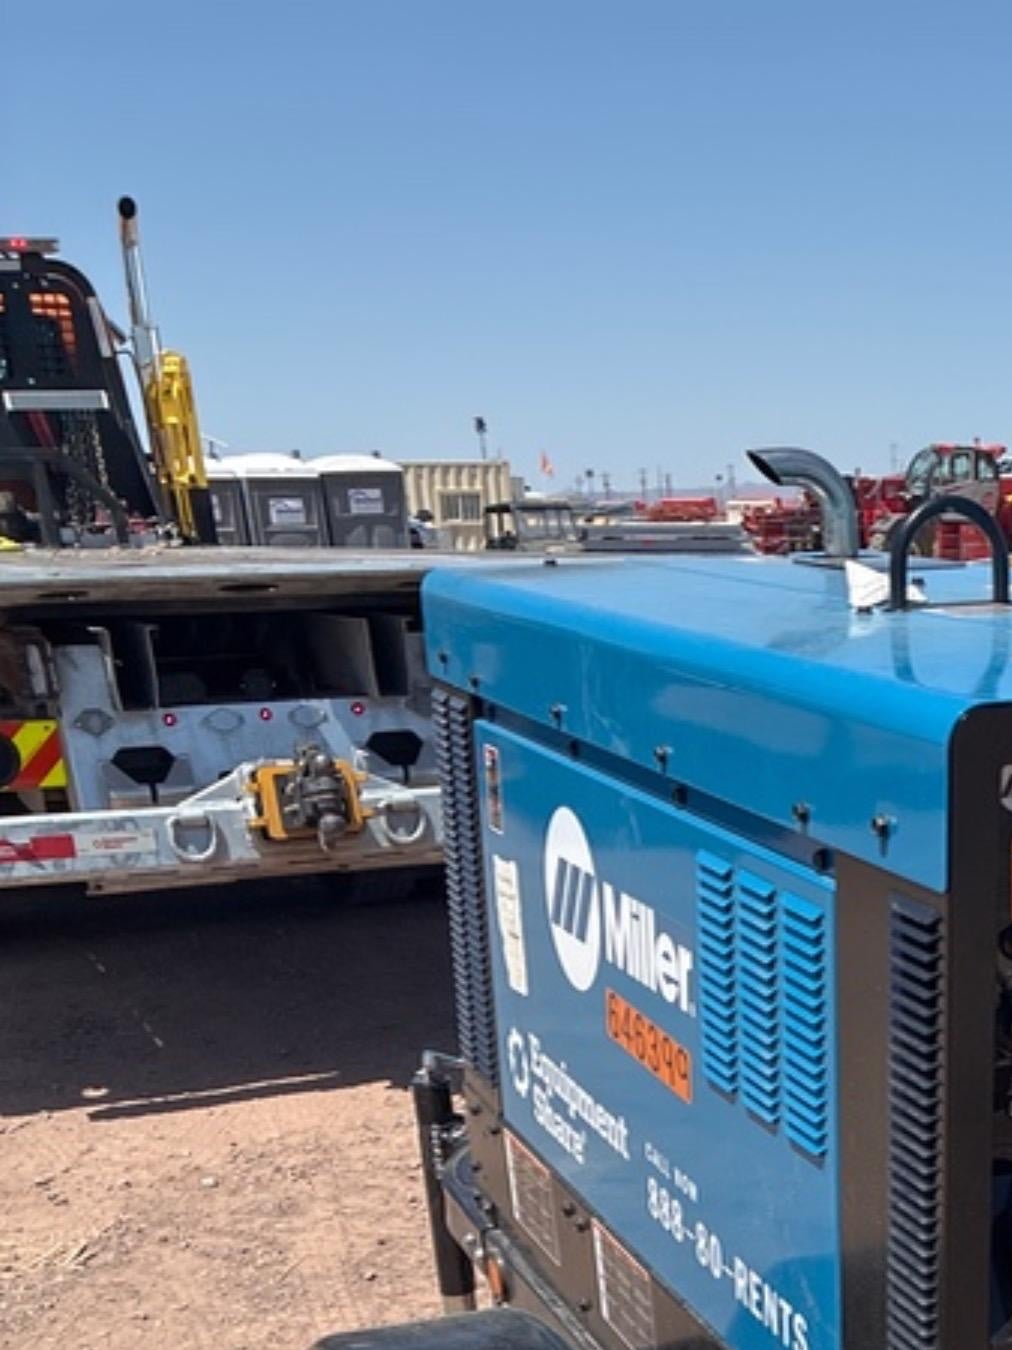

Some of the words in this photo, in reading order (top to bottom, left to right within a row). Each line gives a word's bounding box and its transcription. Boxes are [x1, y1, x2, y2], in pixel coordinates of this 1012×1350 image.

[603, 881, 694, 1014] Miller
[528, 1031, 631, 1160] Equipment
[607, 990, 689, 1096] 646399
[533, 1083, 586, 1165] Share
